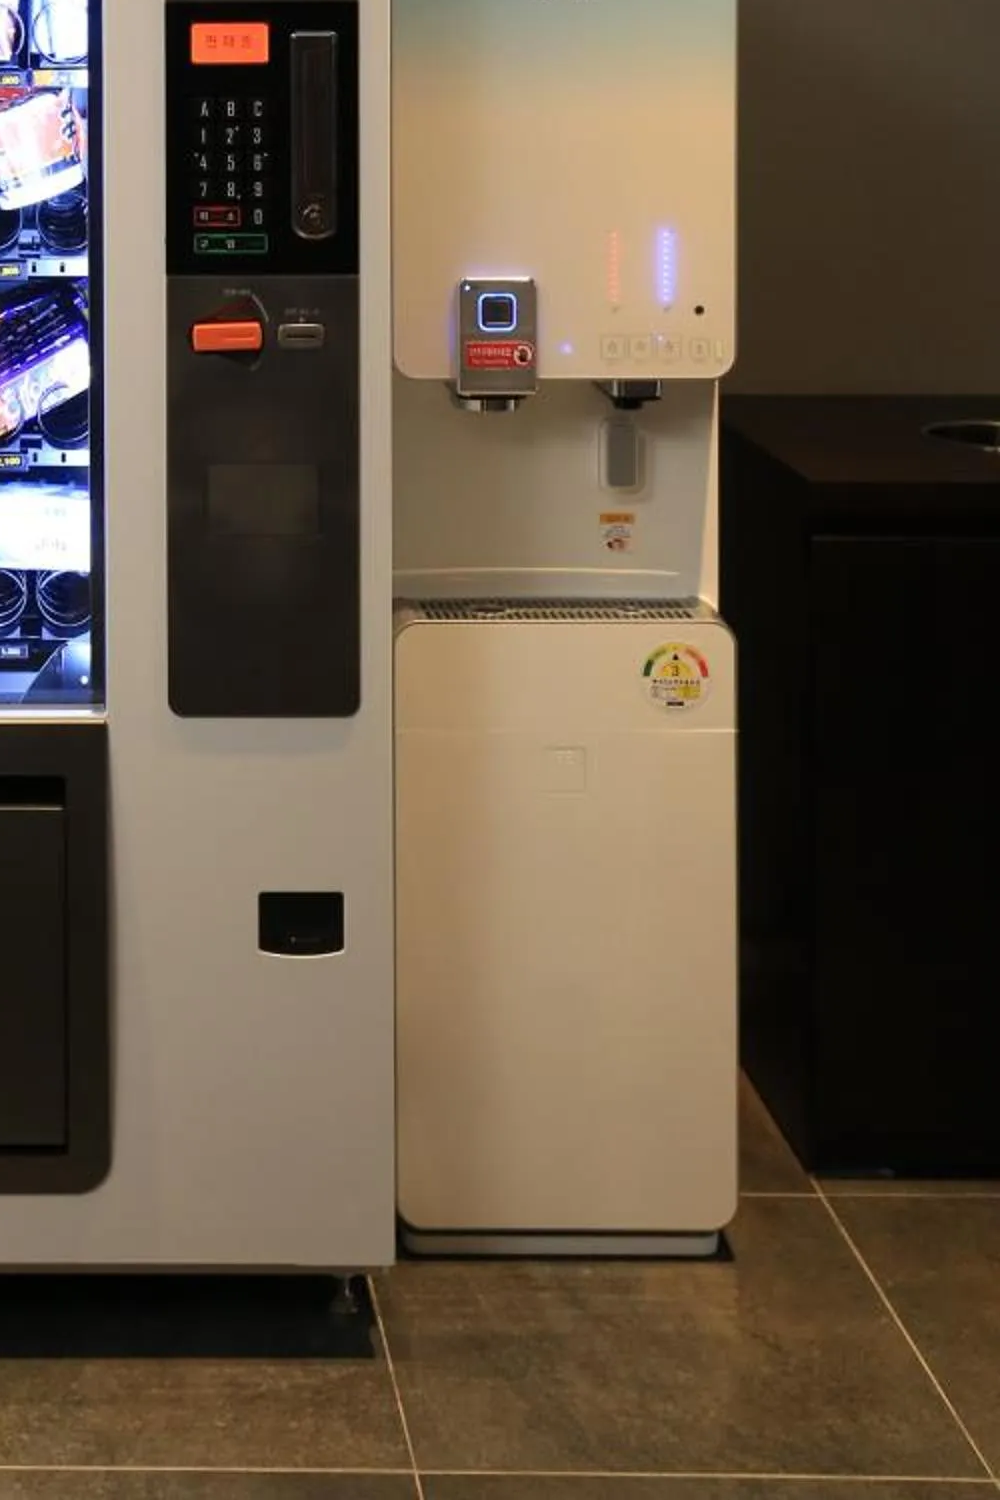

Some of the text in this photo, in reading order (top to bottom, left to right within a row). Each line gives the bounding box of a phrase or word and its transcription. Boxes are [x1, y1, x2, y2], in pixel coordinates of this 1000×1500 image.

[199, 101, 209, 116] A
[226, 128, 235, 144] 2
[253, 128, 262, 144] 3
[199, 155, 208, 171] 4
[226, 155, 236, 171] 5
